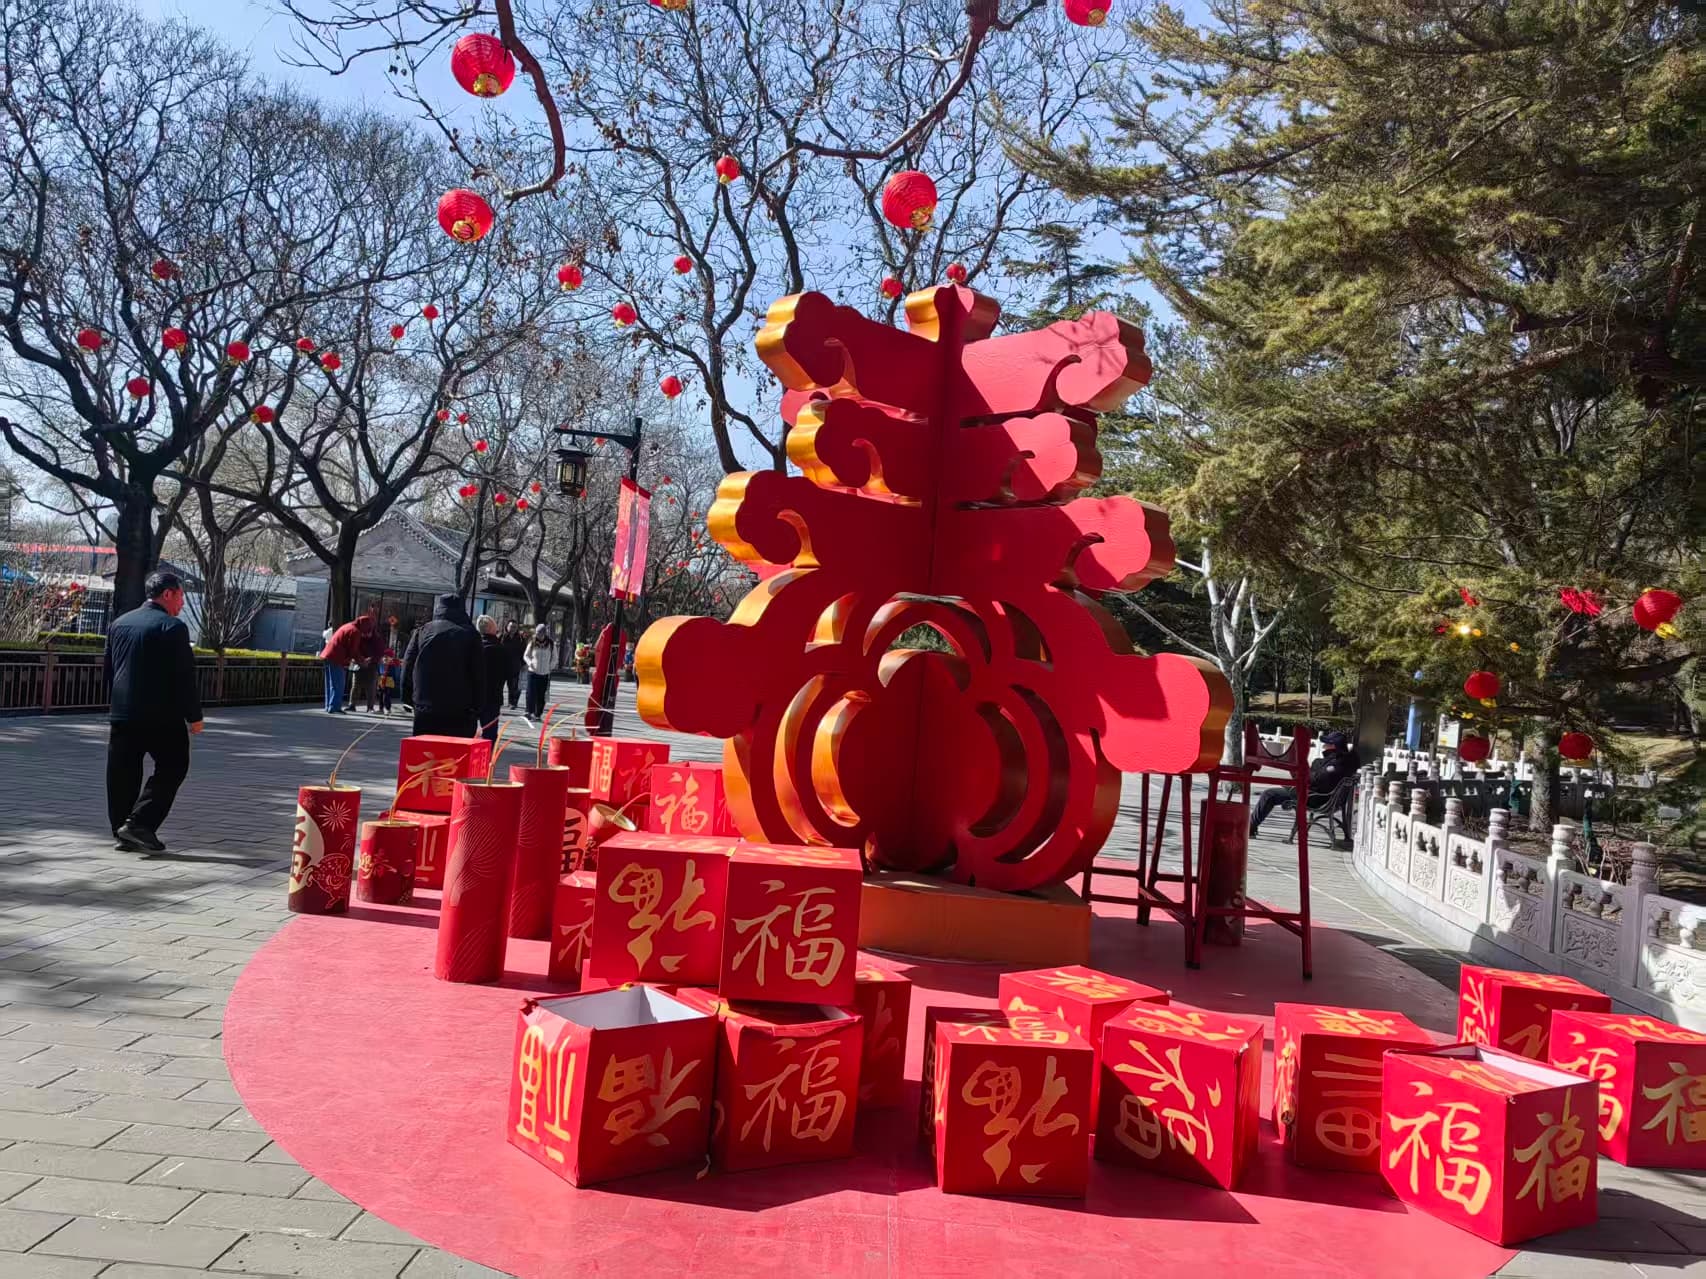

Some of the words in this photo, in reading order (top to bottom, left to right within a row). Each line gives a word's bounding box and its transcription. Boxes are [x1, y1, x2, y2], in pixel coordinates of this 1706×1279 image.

[406, 752, 458, 798] 福
[592, 742, 613, 793] 福
[654, 772, 709, 834] 福
[731, 879, 846, 987] 福
[597, 1048, 702, 1147] 福
[741, 1037, 847, 1153] 福
[1113, 1039, 1222, 1160] 福
[1386, 1081, 1493, 1216] 福
[1513, 1088, 1590, 1213] 福
